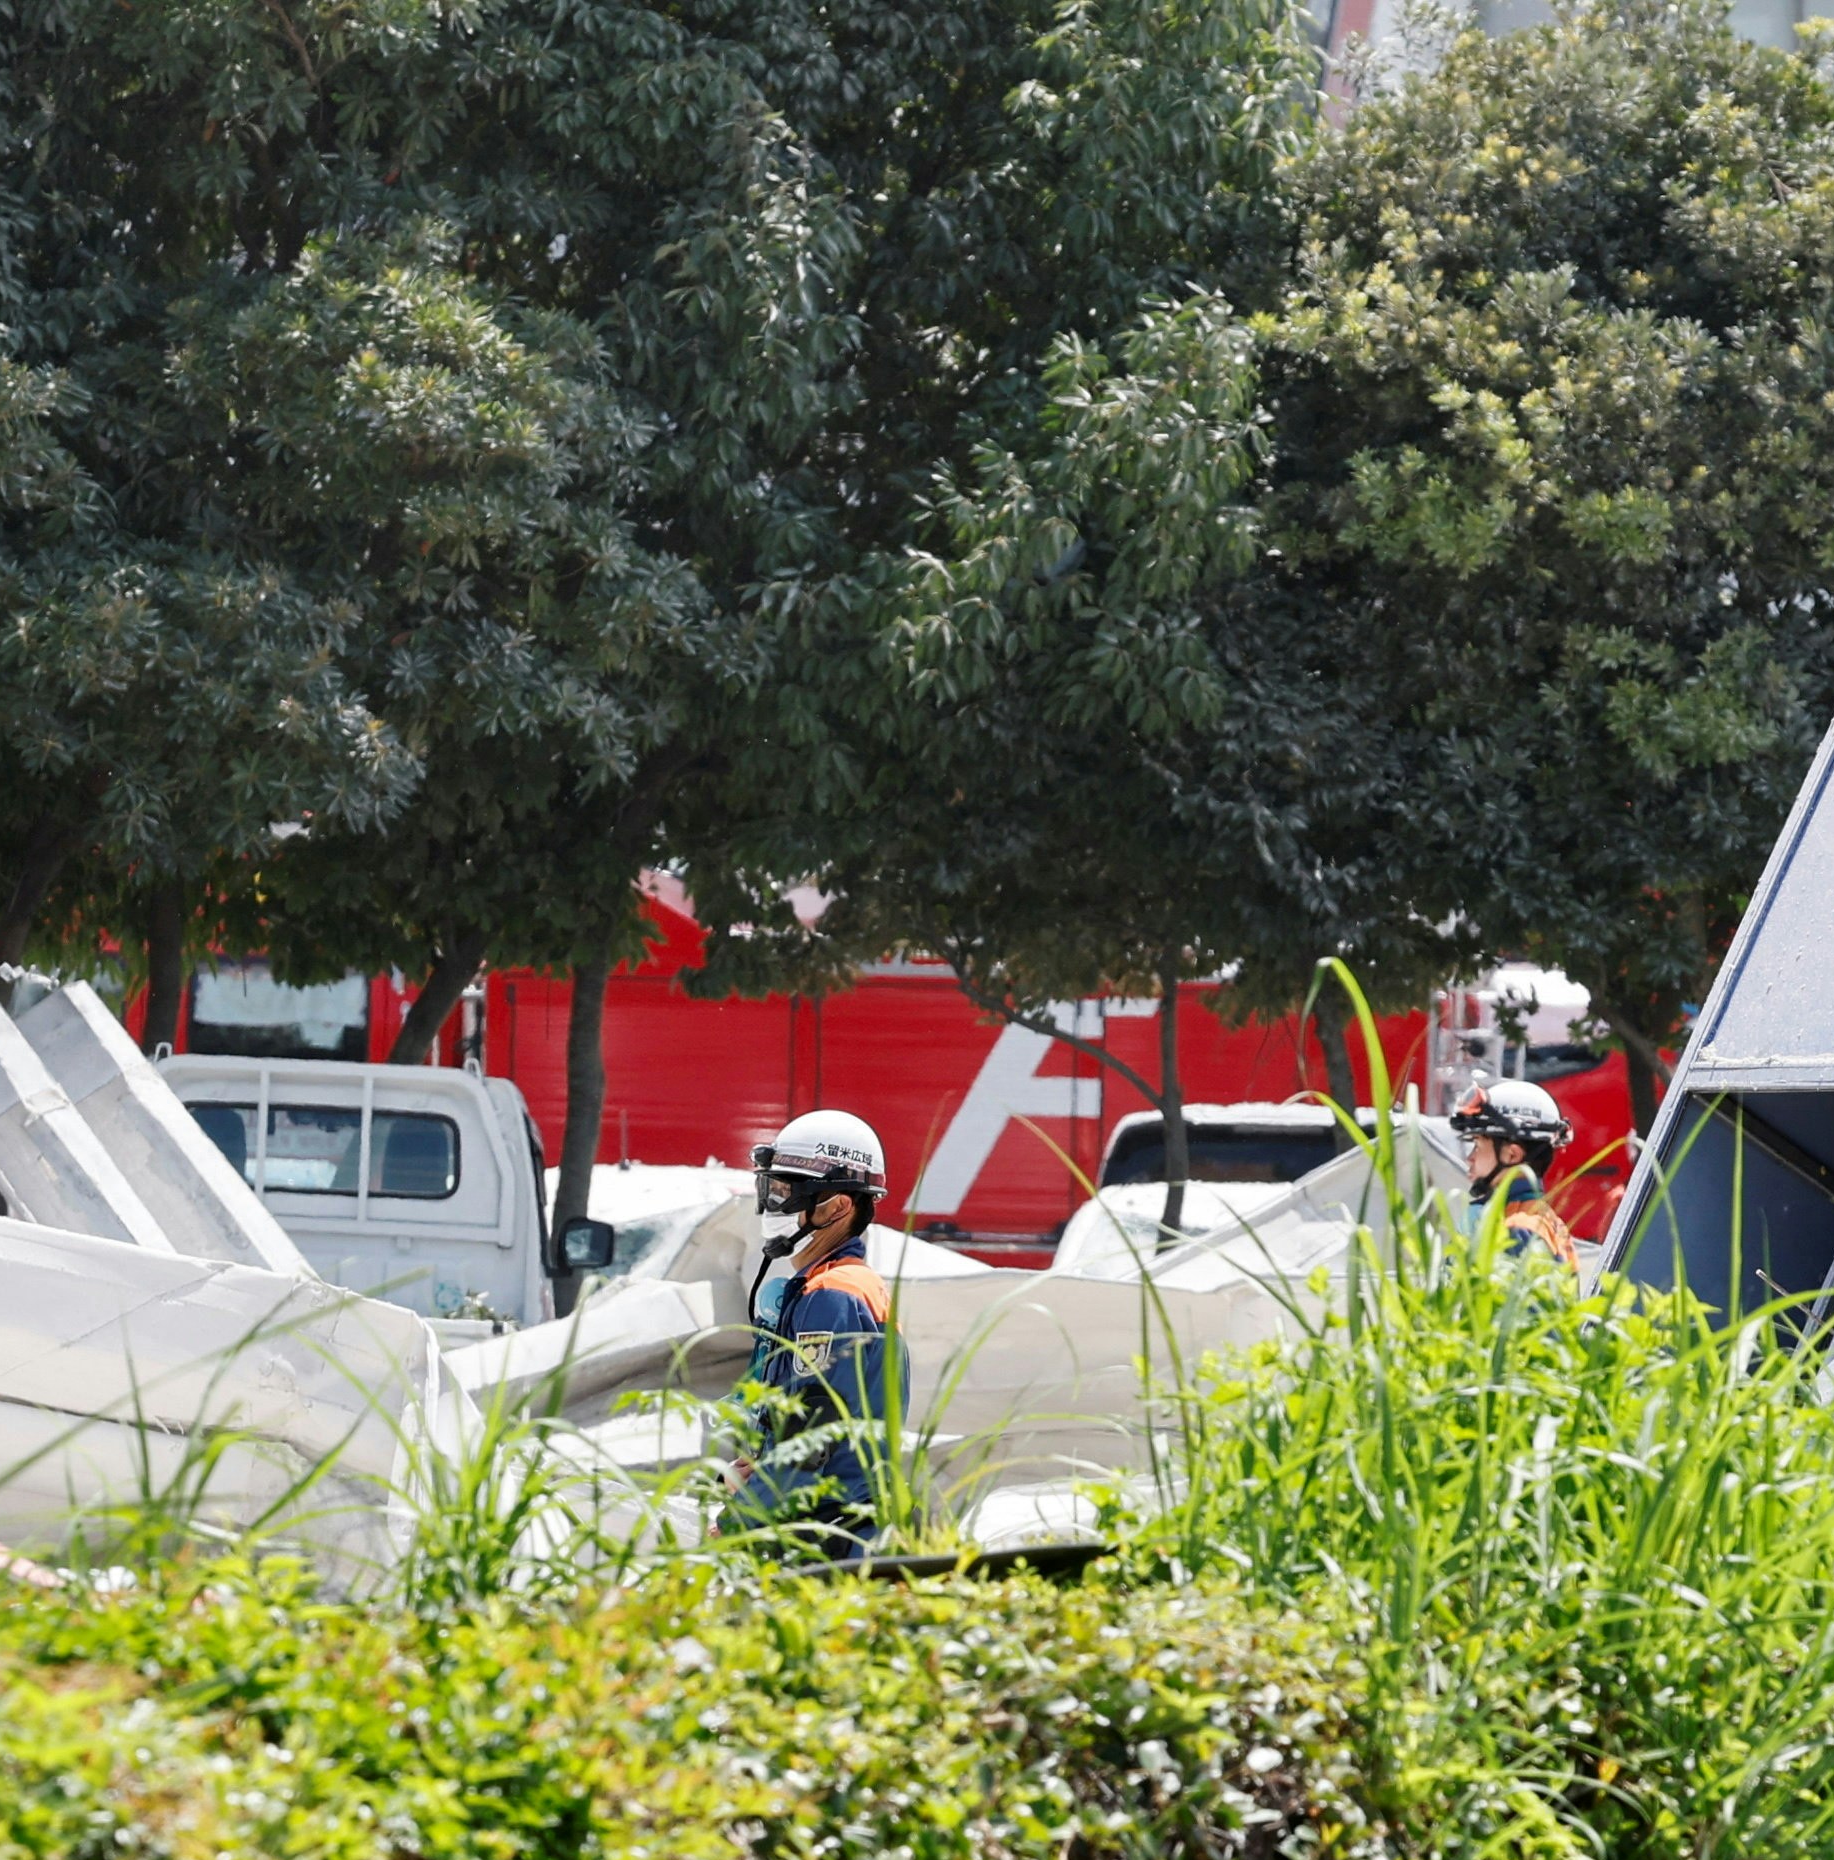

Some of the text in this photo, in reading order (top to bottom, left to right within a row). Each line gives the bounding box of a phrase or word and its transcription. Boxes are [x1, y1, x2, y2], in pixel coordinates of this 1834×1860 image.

[814, 1141, 874, 1167] 久留米広域
